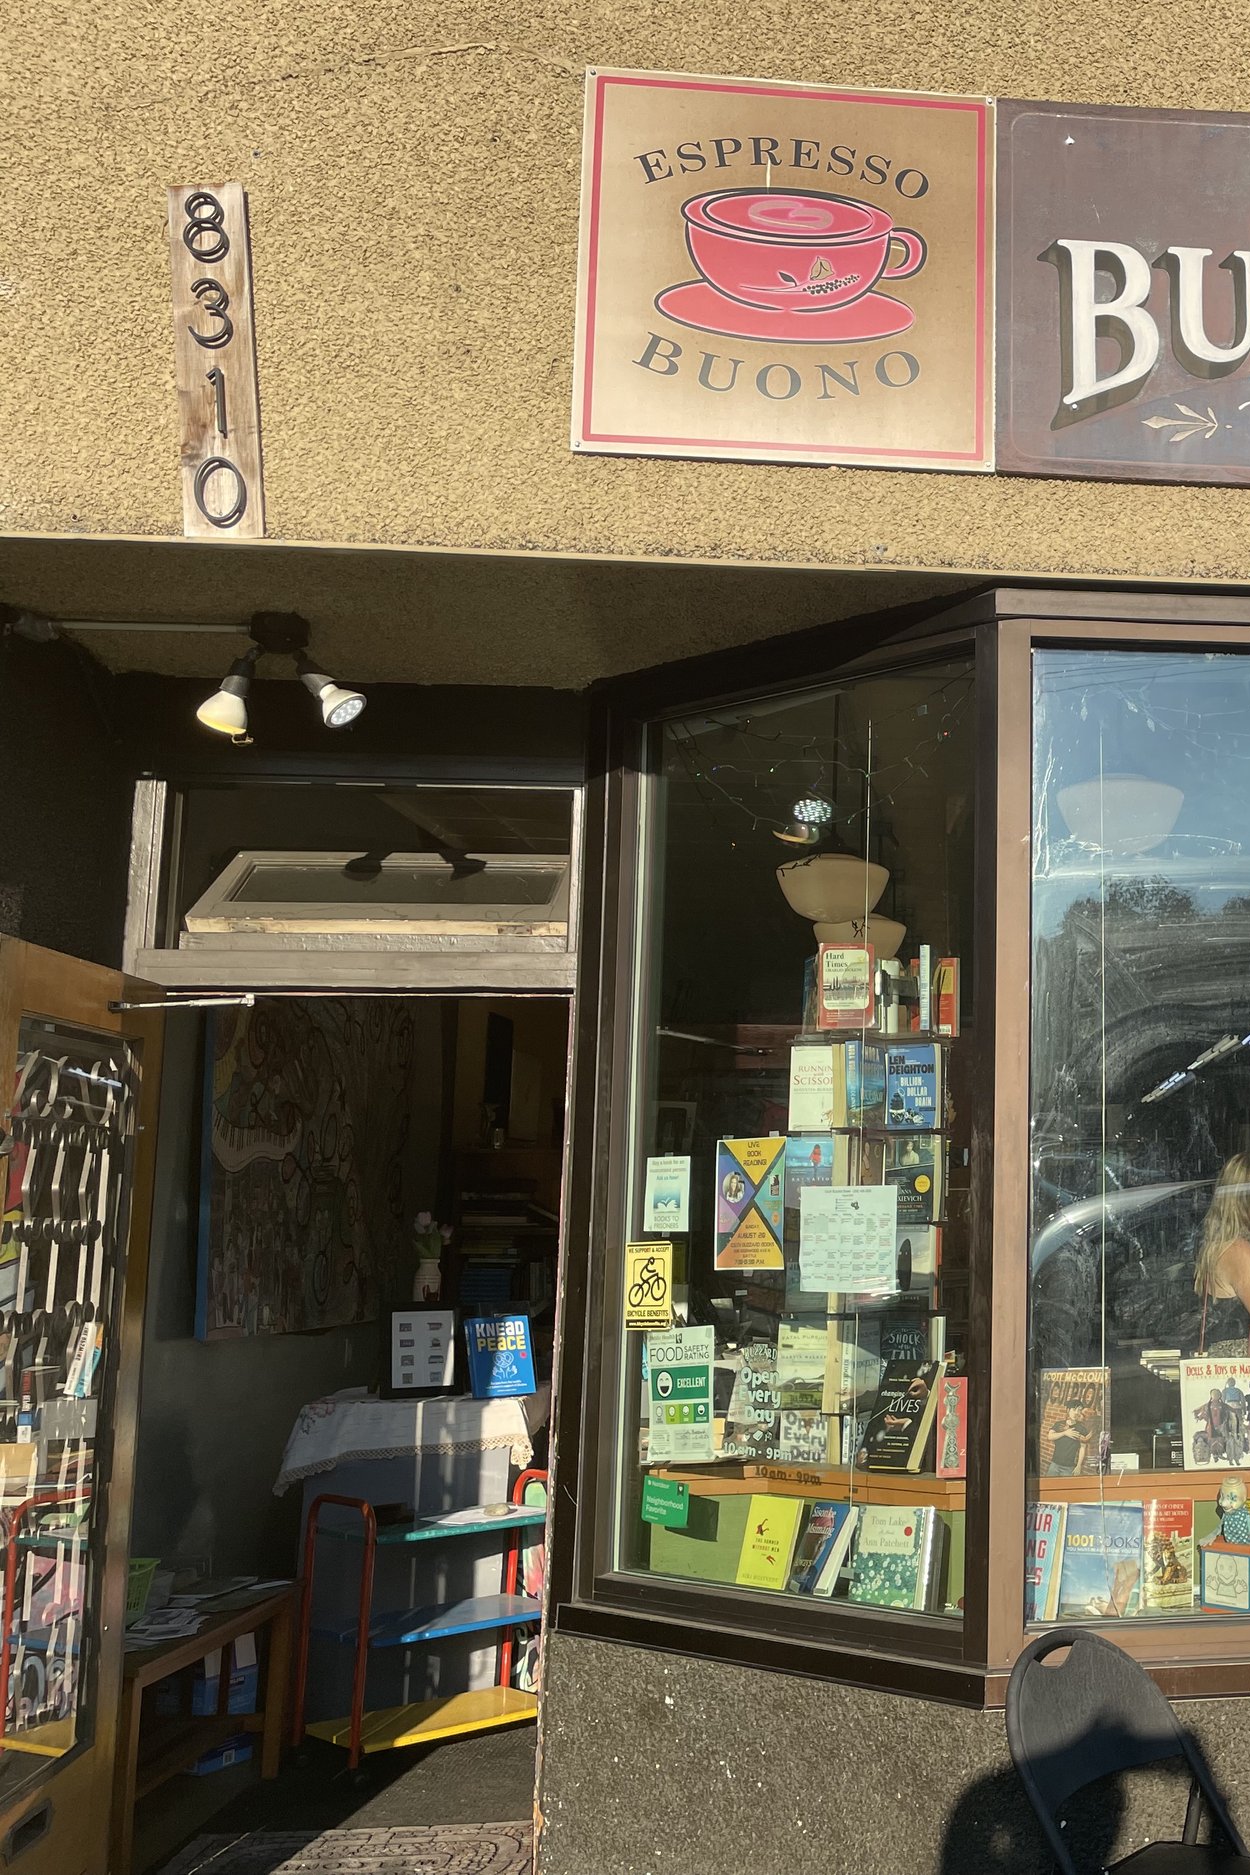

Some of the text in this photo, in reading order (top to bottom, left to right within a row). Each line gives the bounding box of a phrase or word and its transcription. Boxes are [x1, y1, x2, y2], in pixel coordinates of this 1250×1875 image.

[633, 137, 930, 199] ESPRESSO
[182, 191, 247, 529] 8310
[631, 331, 920, 400] BUONO
[825, 952, 845, 960] Hard
[825, 960, 848, 968] Times
[889, 1056, 905, 1064] LEN
[889, 1064, 934, 1075] DEIGHTON
[906, 1087, 928, 1097] DOLLAR
[914, 1097, 932, 1106] BRAIN
[889, 1332, 921, 1345] SHOCK
[649, 1345, 709, 1362] FOOD SAFETY
[684, 1351, 710, 1360] RATING
[740, 1366, 781, 1388] Open
[1186, 1366, 1204, 1377] DOLLS
[1205, 1364, 1212, 1374] &
[1214, 1364, 1228, 1375] TOYS
[1229, 1365, 1237, 1374] OF
[677, 1377, 707, 1389] EXCELLENT
[739, 1385, 782, 1408] Every
[881, 1390, 905, 1399] changing
[889, 1399, 921, 1413] LIVES
[744, 1405, 775, 1427] Day
[645, 1503, 667, 1516] Favorite
[646, 1495, 684, 1511] Neighborhood
[871, 1515, 908, 1526] Tom Lake
[879, 1538, 909, 1548] Patchett
[1067, 1535, 1094, 1548] 1001
